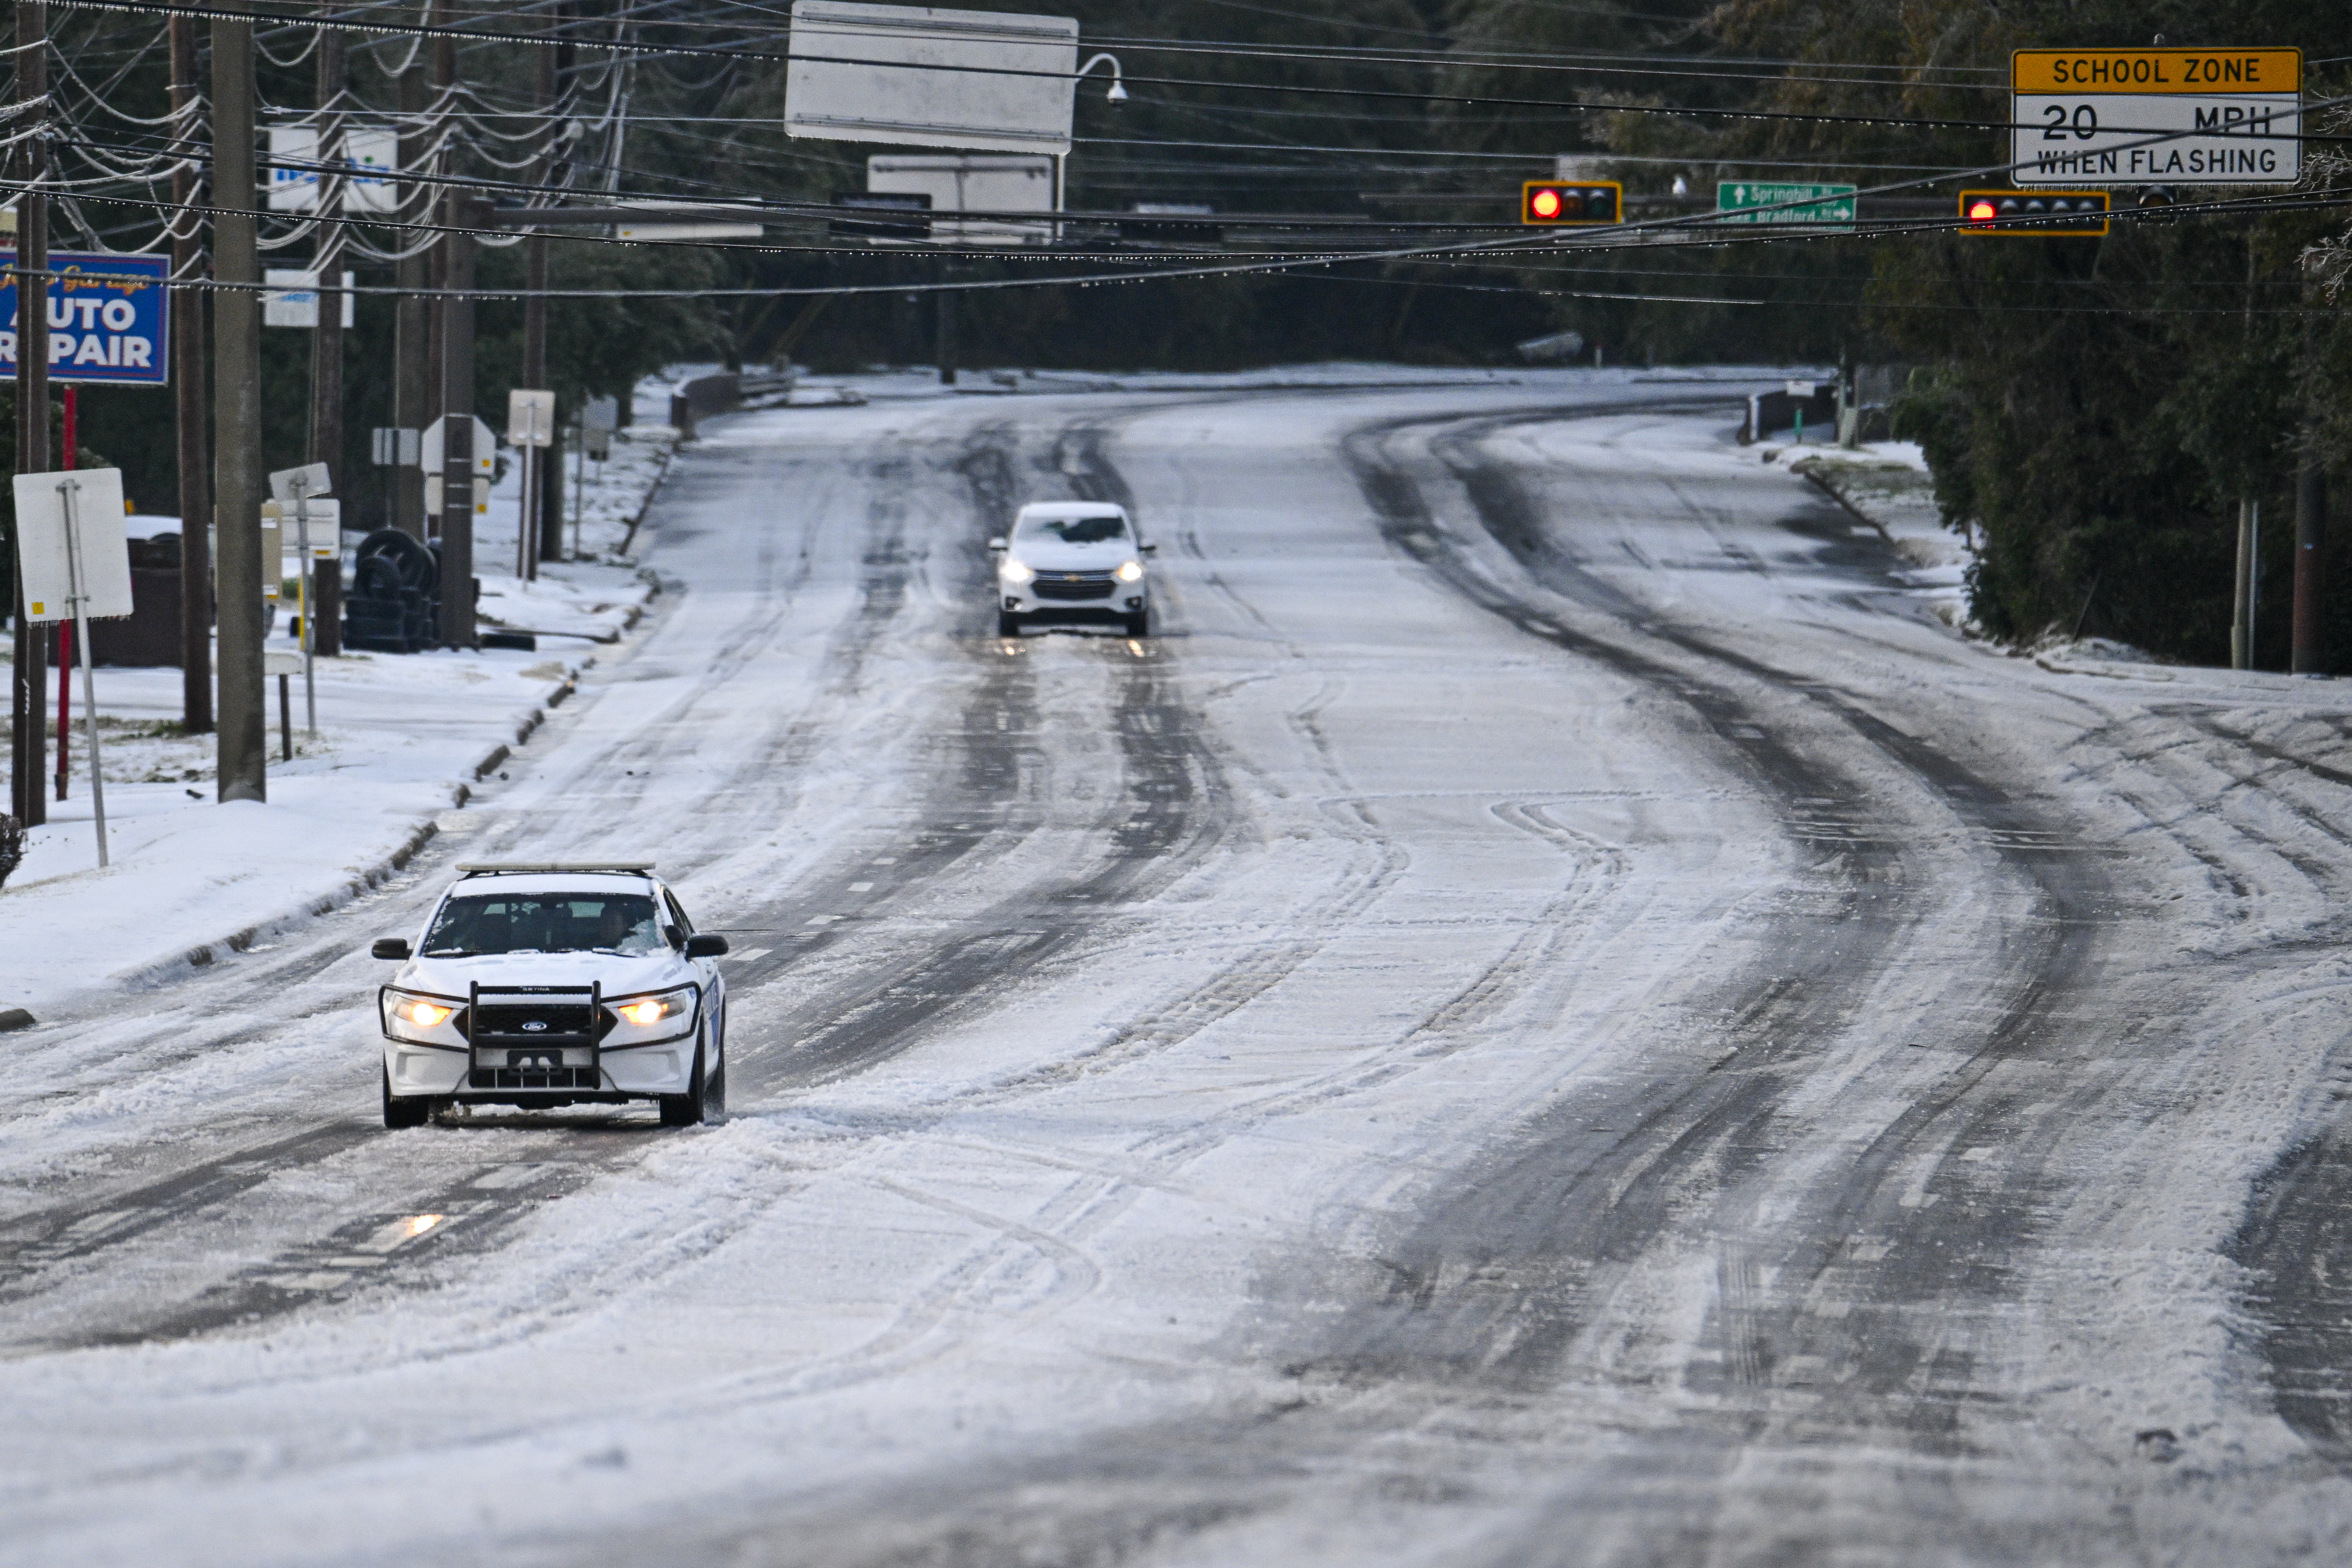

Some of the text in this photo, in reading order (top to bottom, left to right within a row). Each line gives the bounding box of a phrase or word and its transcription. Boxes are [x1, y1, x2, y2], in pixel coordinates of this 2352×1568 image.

[2053, 58, 2261, 84] SCHOOL ZONE
[2042, 104, 2271, 141] 20 MPH
[2038, 149, 2276, 174] WHEN FLASHING
[9, 297, 136, 332] UTO
[0, 331, 152, 368] RPAIR
